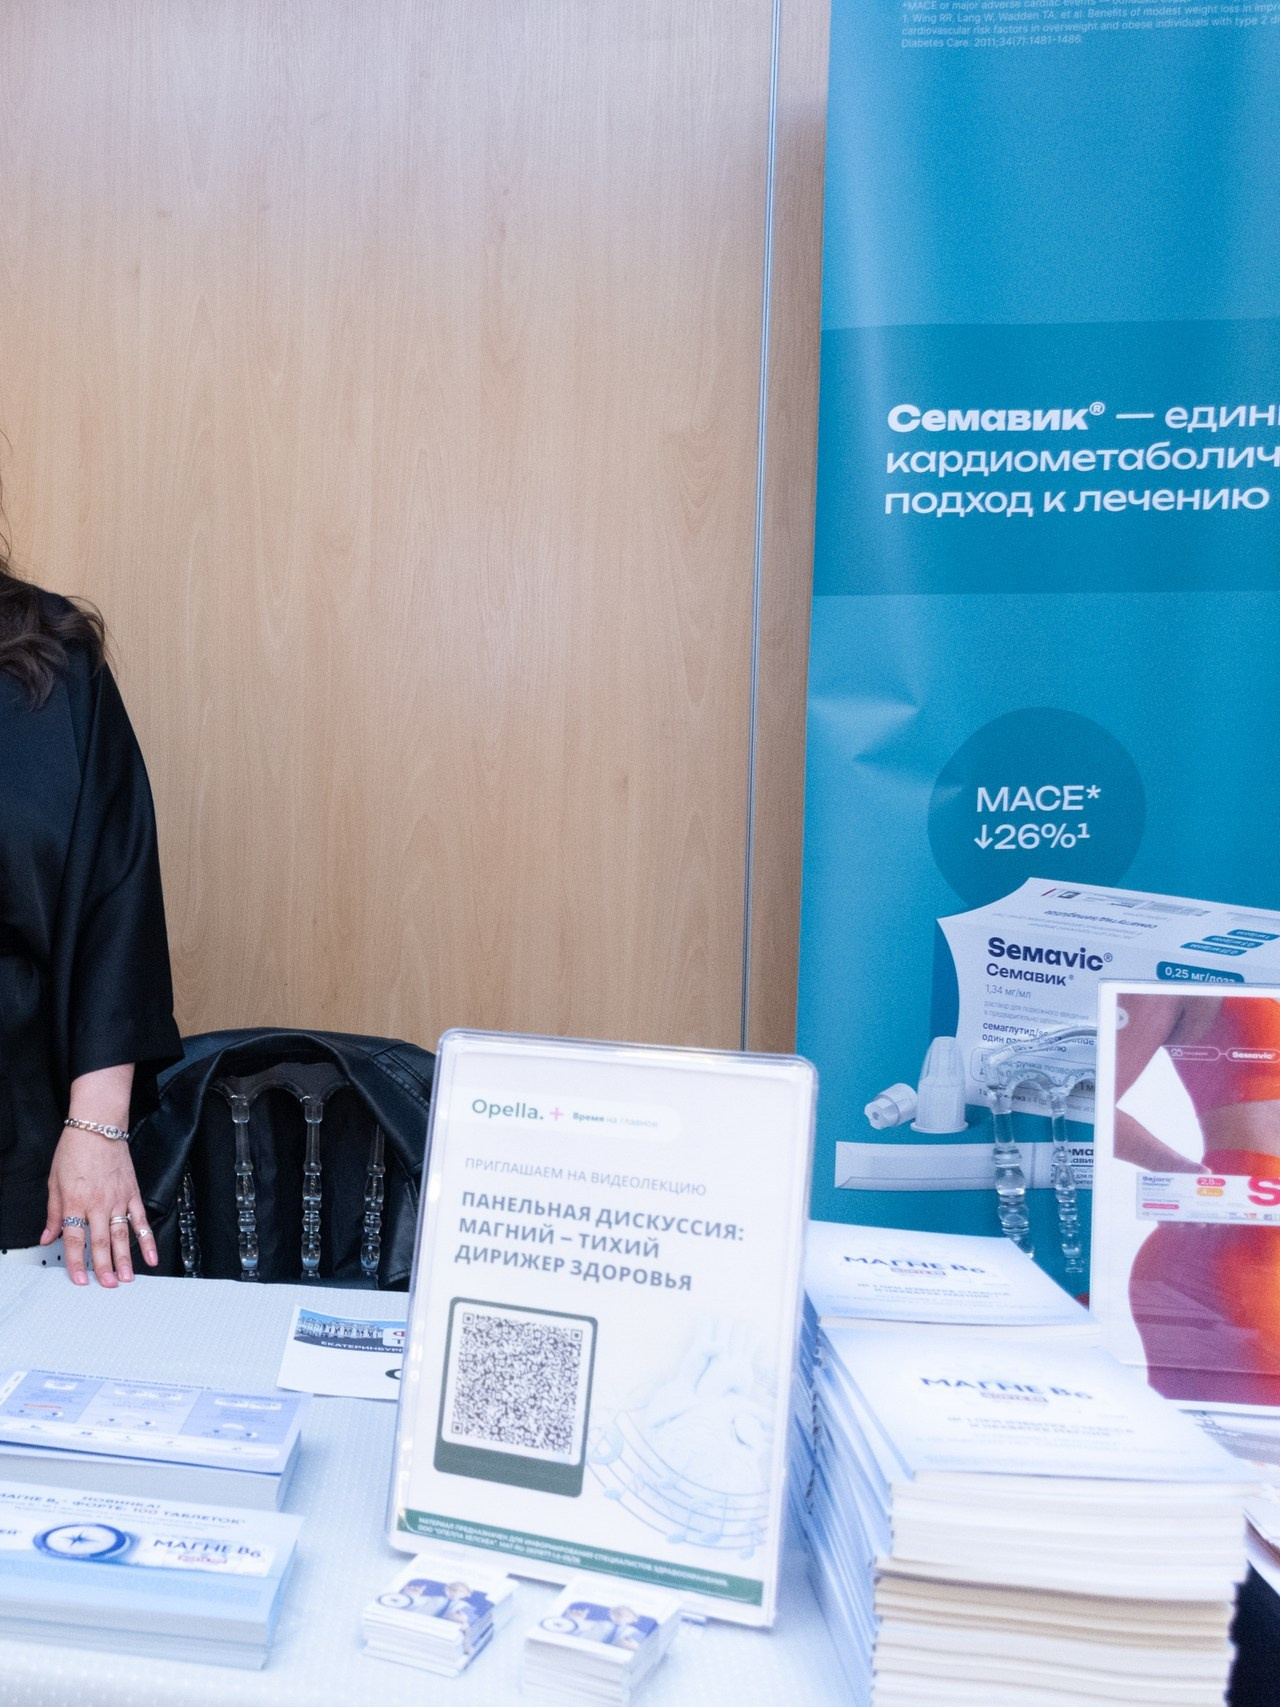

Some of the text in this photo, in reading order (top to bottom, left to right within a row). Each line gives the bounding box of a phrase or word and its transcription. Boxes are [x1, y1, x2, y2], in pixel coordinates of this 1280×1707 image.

[912, 14, 937, 24] Wing
[957, 12, 981, 24] Lang
[998, 11, 1039, 22] Wadden
[1088, 8, 1128, 18] Benefits
[1130, 8, 1140, 16] of
[1143, 6, 1180, 16] modest
[1185, 5, 1218, 16] weight
[1220, 4, 1240, 14] loss
[1242, 4, 1252, 12] in
[952, 0, 978, 11] major
[981, 0, 1021, 9] adverse
[1023, 0, 1060, 8] cardiac
[901, 14, 1268, 36] cardiovascular risk factors in overweight and obese individuals with type 2
[902, 38, 944, 48] Diabetes
[1164, 404, 1280, 433] един
[886, 441, 1280, 478] кардиометаболич
[885, 487, 1270, 518] подход к лечению
[1164, 966, 1189, 978] 0,25
[986, 984, 1032, 999] 1,34 мг/мл
[982, 1034, 1004, 1044] один
[471, 1098, 545, 1120] Opella.
[572, 1112, 605, 1124] Время
[620, 1116, 658, 1128] главное
[465, 1158, 707, 1197] ПРИГЛАШАЕМ НА ВИДЕОЛЕКЦИЮ
[462, 1190, 745, 1242] ПАНЕЛЬНАЯ ДИСКУССИЯ:
[458, 1218, 555, 1245] МАГНИЙ
[579, 1233, 660, 1259] ТИХИЙ
[454, 1244, 693, 1292] ДИРИЖЕР ЗДОРОВЬЯ
[153, 1538, 236, 1556] МАГНЕ
